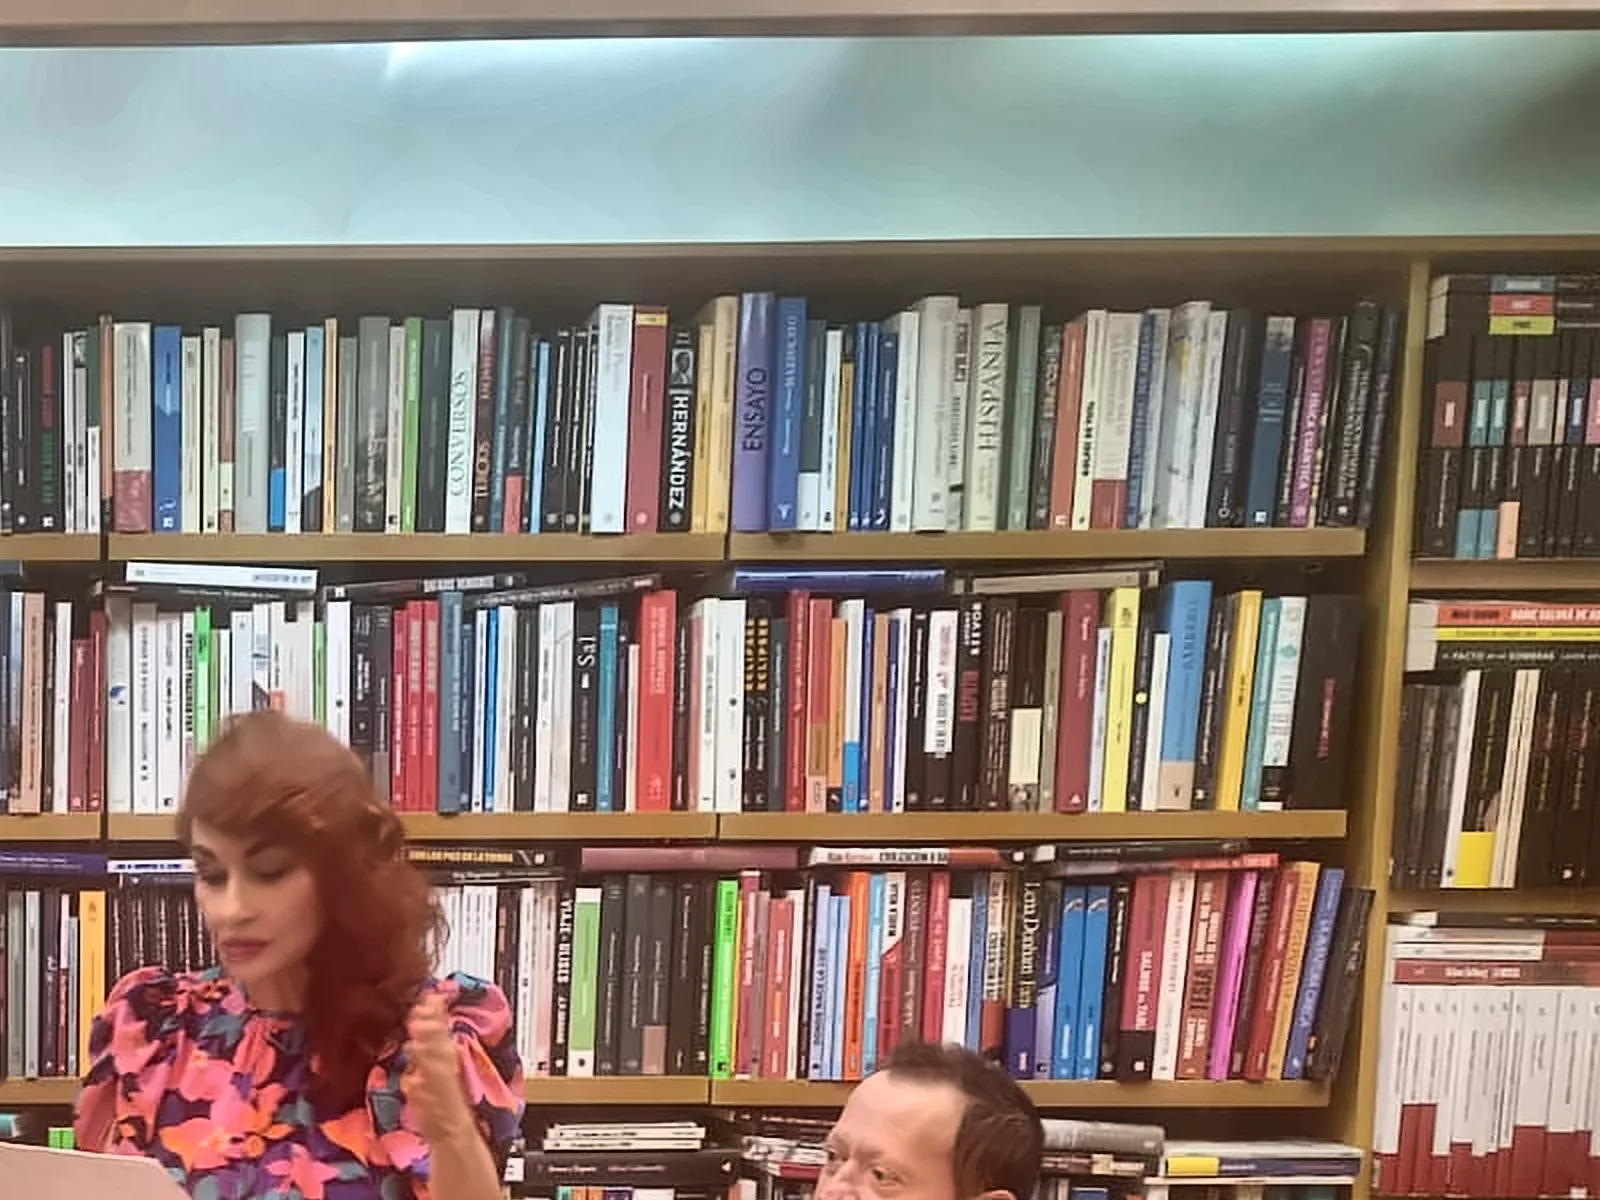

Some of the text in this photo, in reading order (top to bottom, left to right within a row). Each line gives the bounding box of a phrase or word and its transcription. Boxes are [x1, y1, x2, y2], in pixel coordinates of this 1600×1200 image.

[449, 371, 467, 497] CONVERSOS
[742, 367, 767, 451] ENSAYO
[977, 319, 1004, 450] HISPANIA
[668, 395, 691, 509] HERNÁNDEZ
[578, 636, 596, 668] Sal
